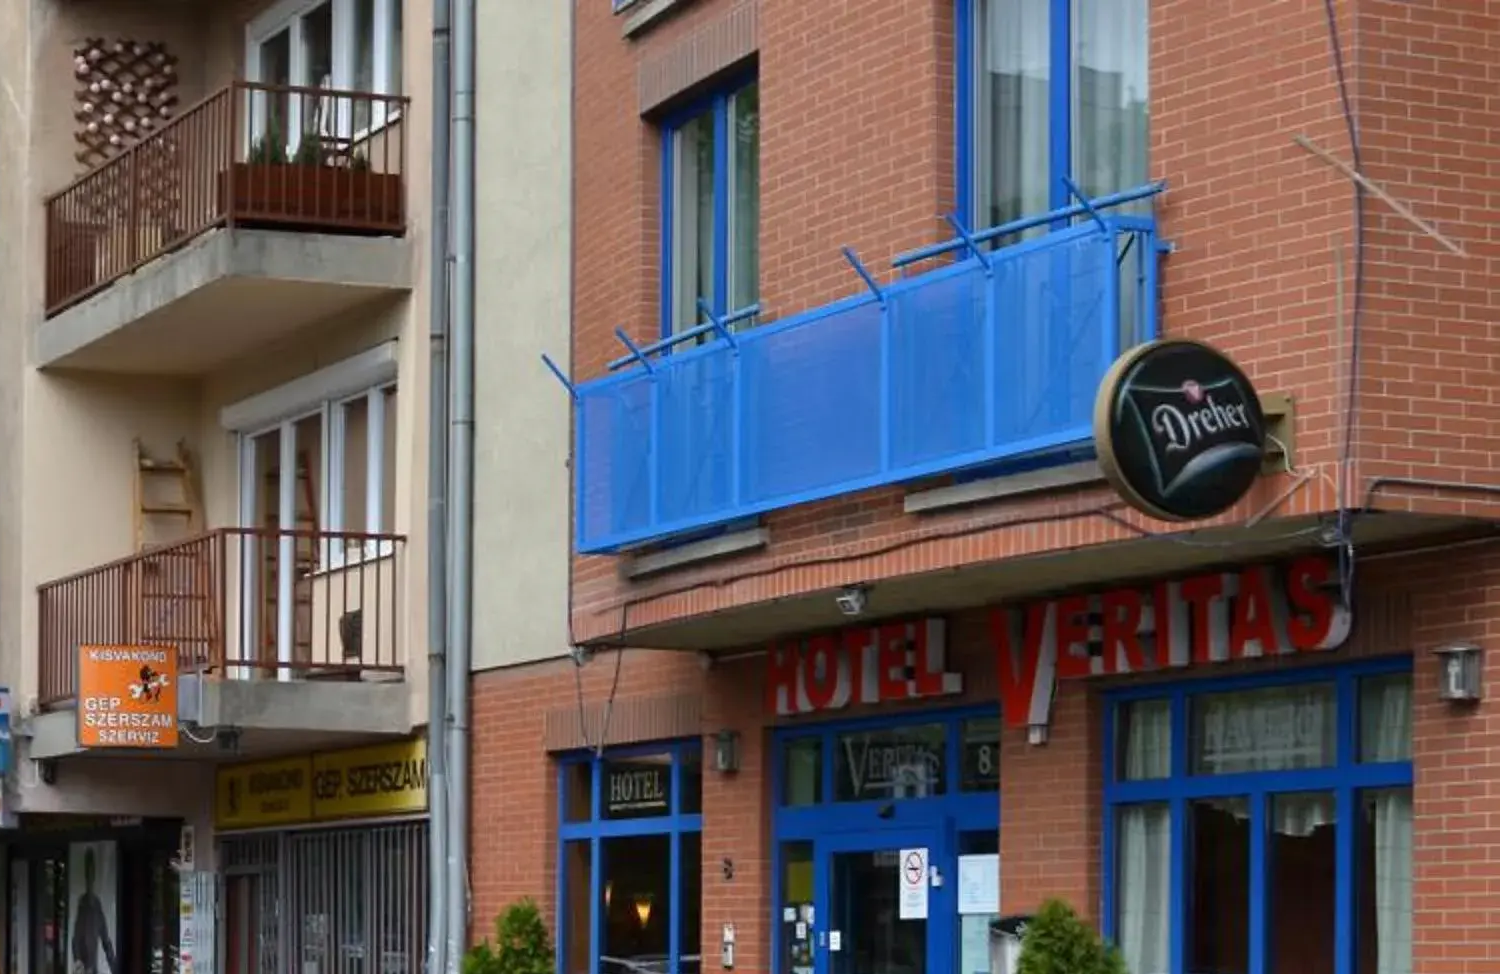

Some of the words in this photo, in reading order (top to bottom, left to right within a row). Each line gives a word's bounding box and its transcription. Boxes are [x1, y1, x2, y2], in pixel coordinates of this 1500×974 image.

[1151, 394, 1250, 450] Dreher
[767, 617, 961, 715] HOTEL
[989, 555, 1351, 731] VERITAS
[98, 729, 160, 744] SZERVIZ
[978, 745, 992, 775] 8
[609, 770, 664, 801] HOTEL
